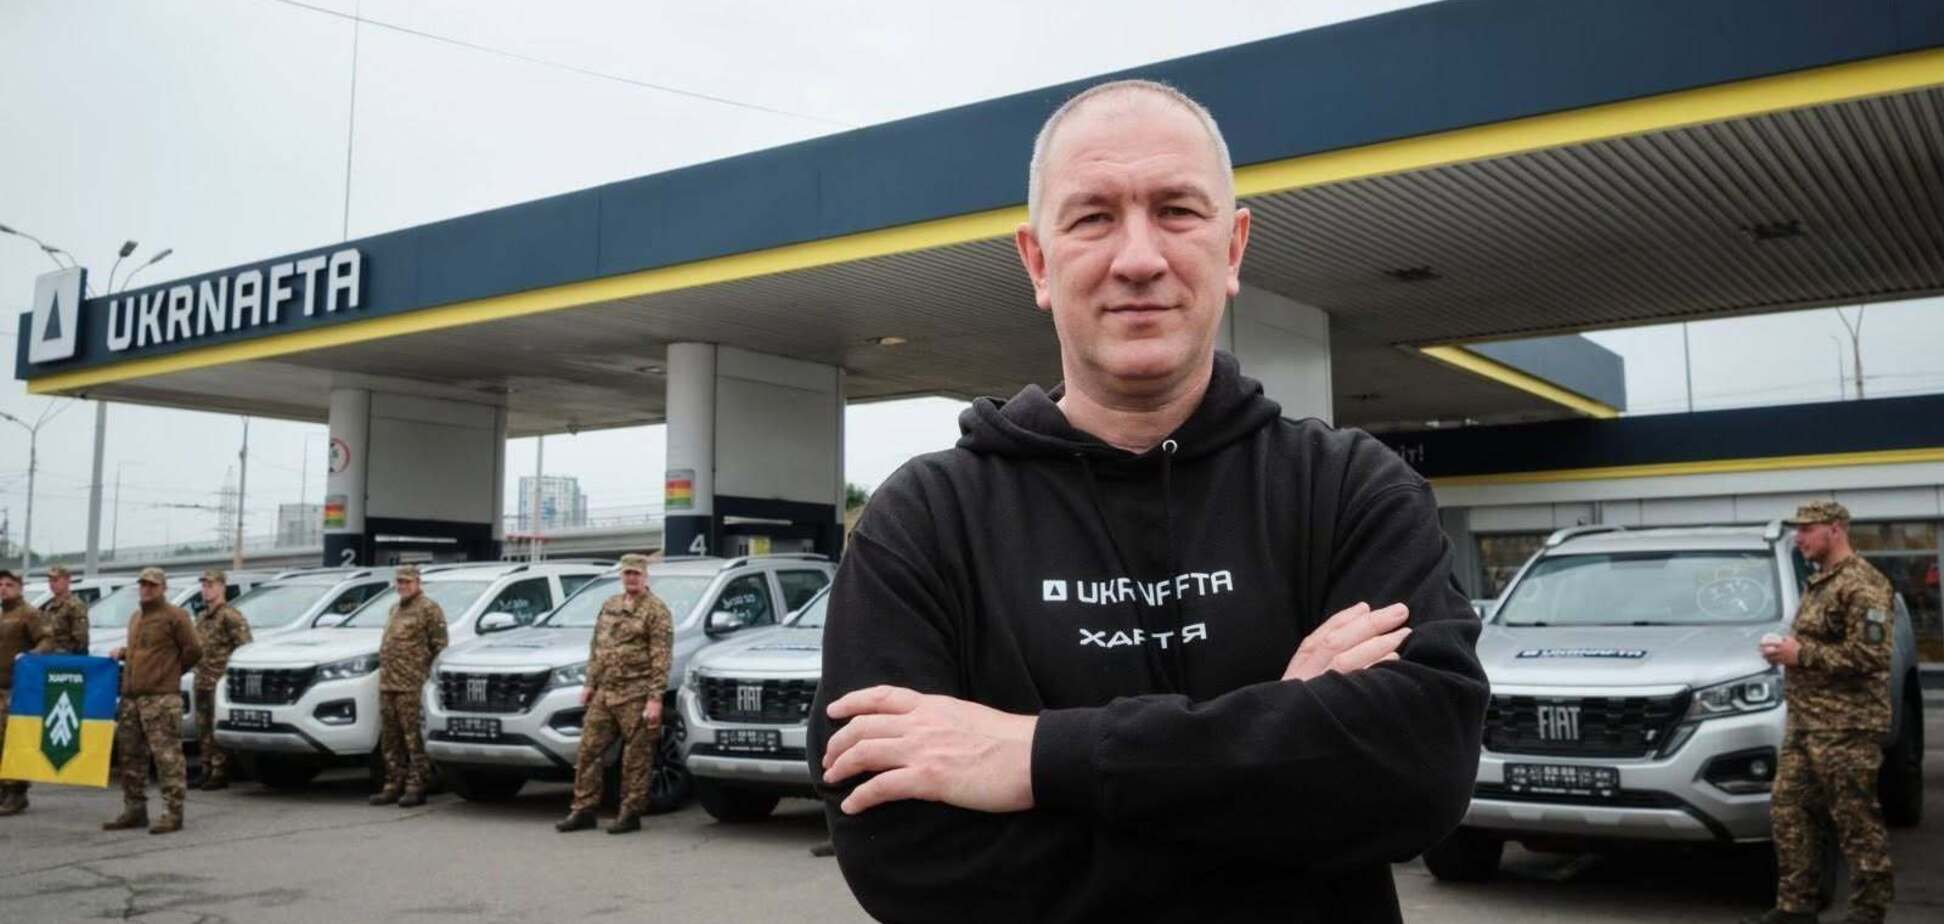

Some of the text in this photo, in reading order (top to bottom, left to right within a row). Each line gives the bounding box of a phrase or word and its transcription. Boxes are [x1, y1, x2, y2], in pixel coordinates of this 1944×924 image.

[106, 248, 362, 352] UKRNAFTA
[340, 548, 356, 567] 2
[688, 534, 707, 556] 4
[1079, 622, 1207, 649] ХАРТЯ
[737, 685, 763, 711] FIAT
[1537, 705, 1581, 740] FIAT
